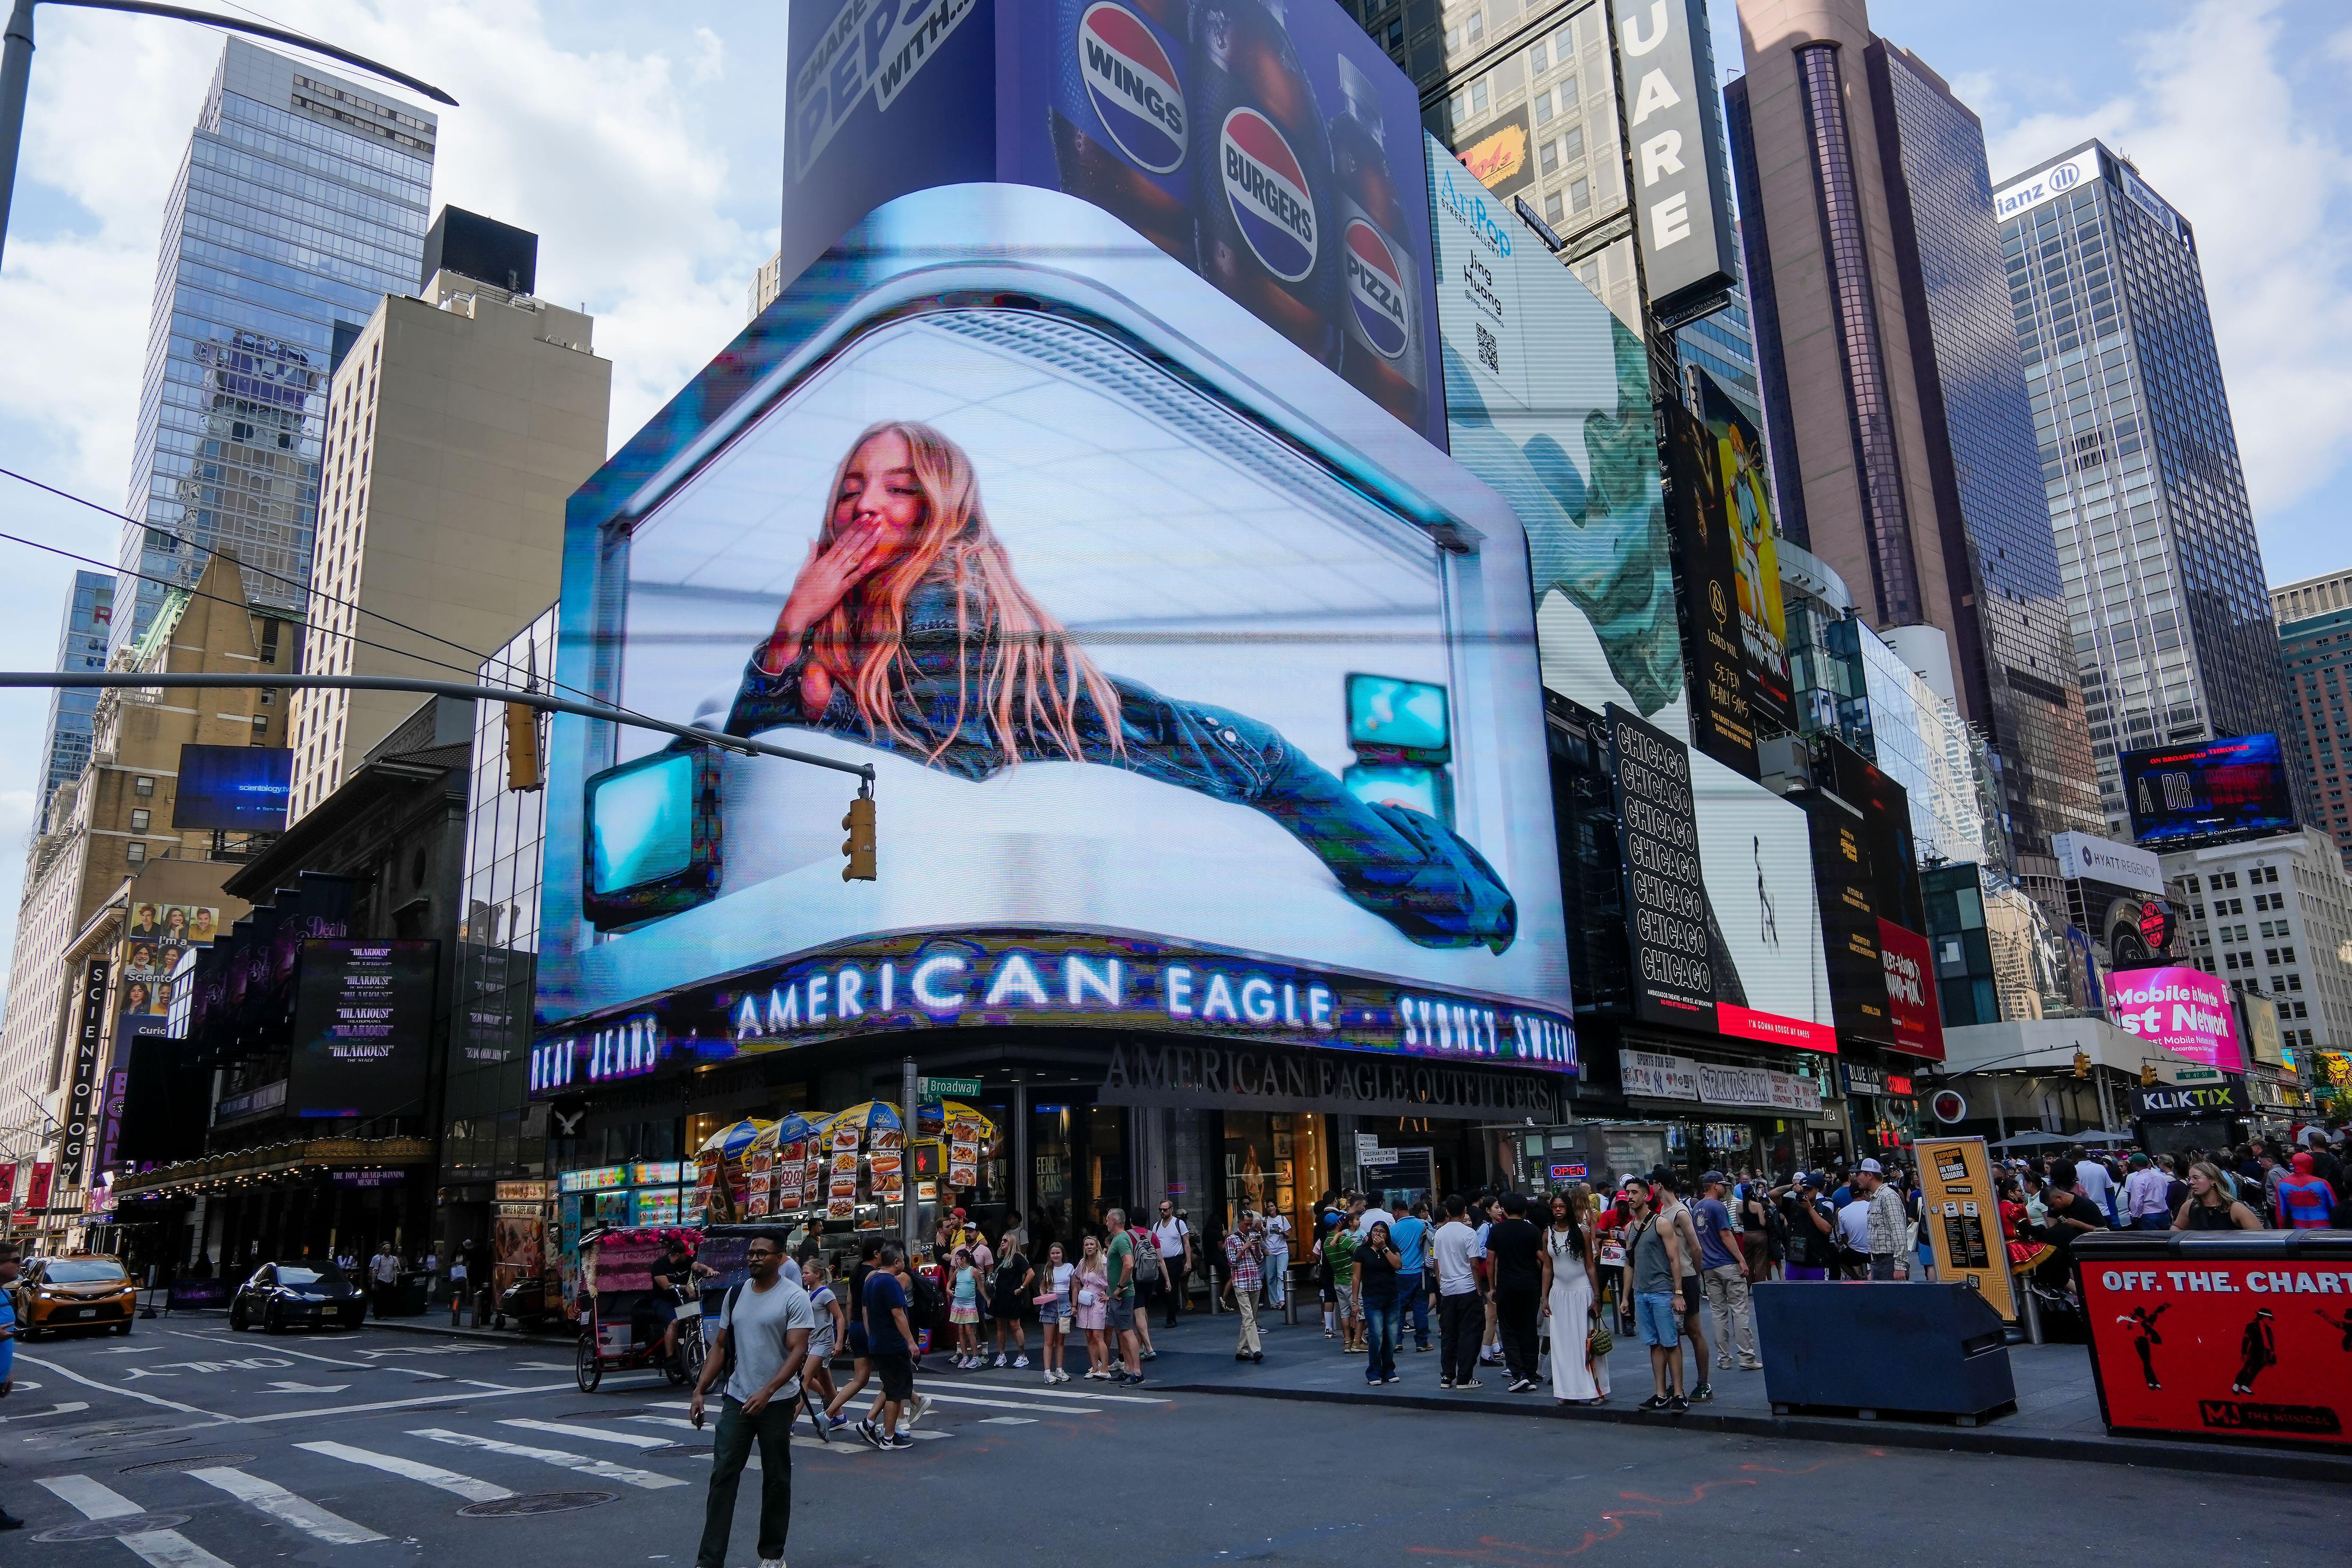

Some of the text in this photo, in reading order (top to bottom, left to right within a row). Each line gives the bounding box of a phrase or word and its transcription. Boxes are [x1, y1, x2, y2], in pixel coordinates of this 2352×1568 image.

[1085, 37, 1183, 136] WINGS
[1226, 142, 1312, 244] BURGERS
[2129, 179, 2161, 219] Allianz
[1441, 169, 1511, 259] ArtPop
[1441, 198, 1500, 258] STREET GALLERY
[1470, 249, 1492, 286] Jing
[1345, 249, 1406, 326] PIZZA
[1463, 264, 1502, 316] Huang
[1465, 290, 1504, 328] @jing_ceramics
[1708, 629, 1739, 659] LORD NIL
[1708, 679, 1730, 709] DEADLY
[1732, 694, 1749, 719] SINS
[1715, 724, 1727, 736] SHOW
[1732, 732, 1741, 743] NEW
[1741, 736, 1752, 750] YORK
[1719, 713, 1730, 727] MOST
[1730, 719, 1753, 740] DANGEROUS
[1617, 723, 1687, 782] CHICAGO
[2162, 752, 2206, 763] BROADWAY
[2208, 744, 2249, 755] THROUGH
[239, 784, 290, 794] scientology.tv
[1621, 759, 1691, 816] CHICAGO
[2138, 777, 2154, 813] A
[1625, 796, 1695, 852] CHICAGO
[1629, 833, 1699, 886] CHICAGO
[2094, 852, 2155, 879] HYATT REGENCY
[1634, 870, 1702, 922] CHICAGO
[307, 915, 347, 938] Death
[1637, 908, 1707, 956] CHICAGO
[159, 935, 188, 947] I'm a
[1641, 947, 1710, 993] CHICAGO
[1647, 989, 1668, 999] AMBASSADOR
[1668, 993, 1680, 1002] THEATRE
[1699, 999, 1713, 1008] BROADWAY
[2116, 985, 2219, 1008] Mobile is Now the
[138, 1026, 167, 1035] Curio
[591, 1017, 657, 1079] JEANS
[737, 955, 1120, 1040] AMERICAN
[1168, 966, 1334, 1031] EAGLE
[1401, 997, 1497, 1054] SYDNEY
[1758, 1021, 1774, 1032] GONNA
[1775, 1024, 1789, 1035] ROUGE
[1790, 1027, 1796, 1036] MY
[1797, 1029, 1810, 1039] KNEES
[2172, 1004, 2229, 1038] Network
[2164, 1035, 2195, 1045] Mobile
[62, 968, 103, 1175] SCIENTOLOGY
[1637, 1053, 1664, 1068] SPORTS FAN
[1849, 1064, 1866, 1082] BLUE
[930, 1080, 977, 1096] Broadway
[1102, 1041, 1550, 1111] AMERICAN EAGLE OUTFITTERS
[923, 1093, 933, 1103] 46
[2143, 1088, 2234, 1110] KLIKTIX
[1935, 1149, 1961, 1160] EXPLORE
[1937, 1158, 1954, 1167] MORE
[1947, 1163, 1964, 1172] TIMES
[1553, 1166, 1585, 1176] OPEN
[1941, 1170, 1965, 1180] SQUARE
[2102, 1270, 2352, 1294] OFF. THE. CHART
[2205, 1404, 2241, 1425] MJ
[2247, 1411, 2331, 1426] THE MUSICAL
